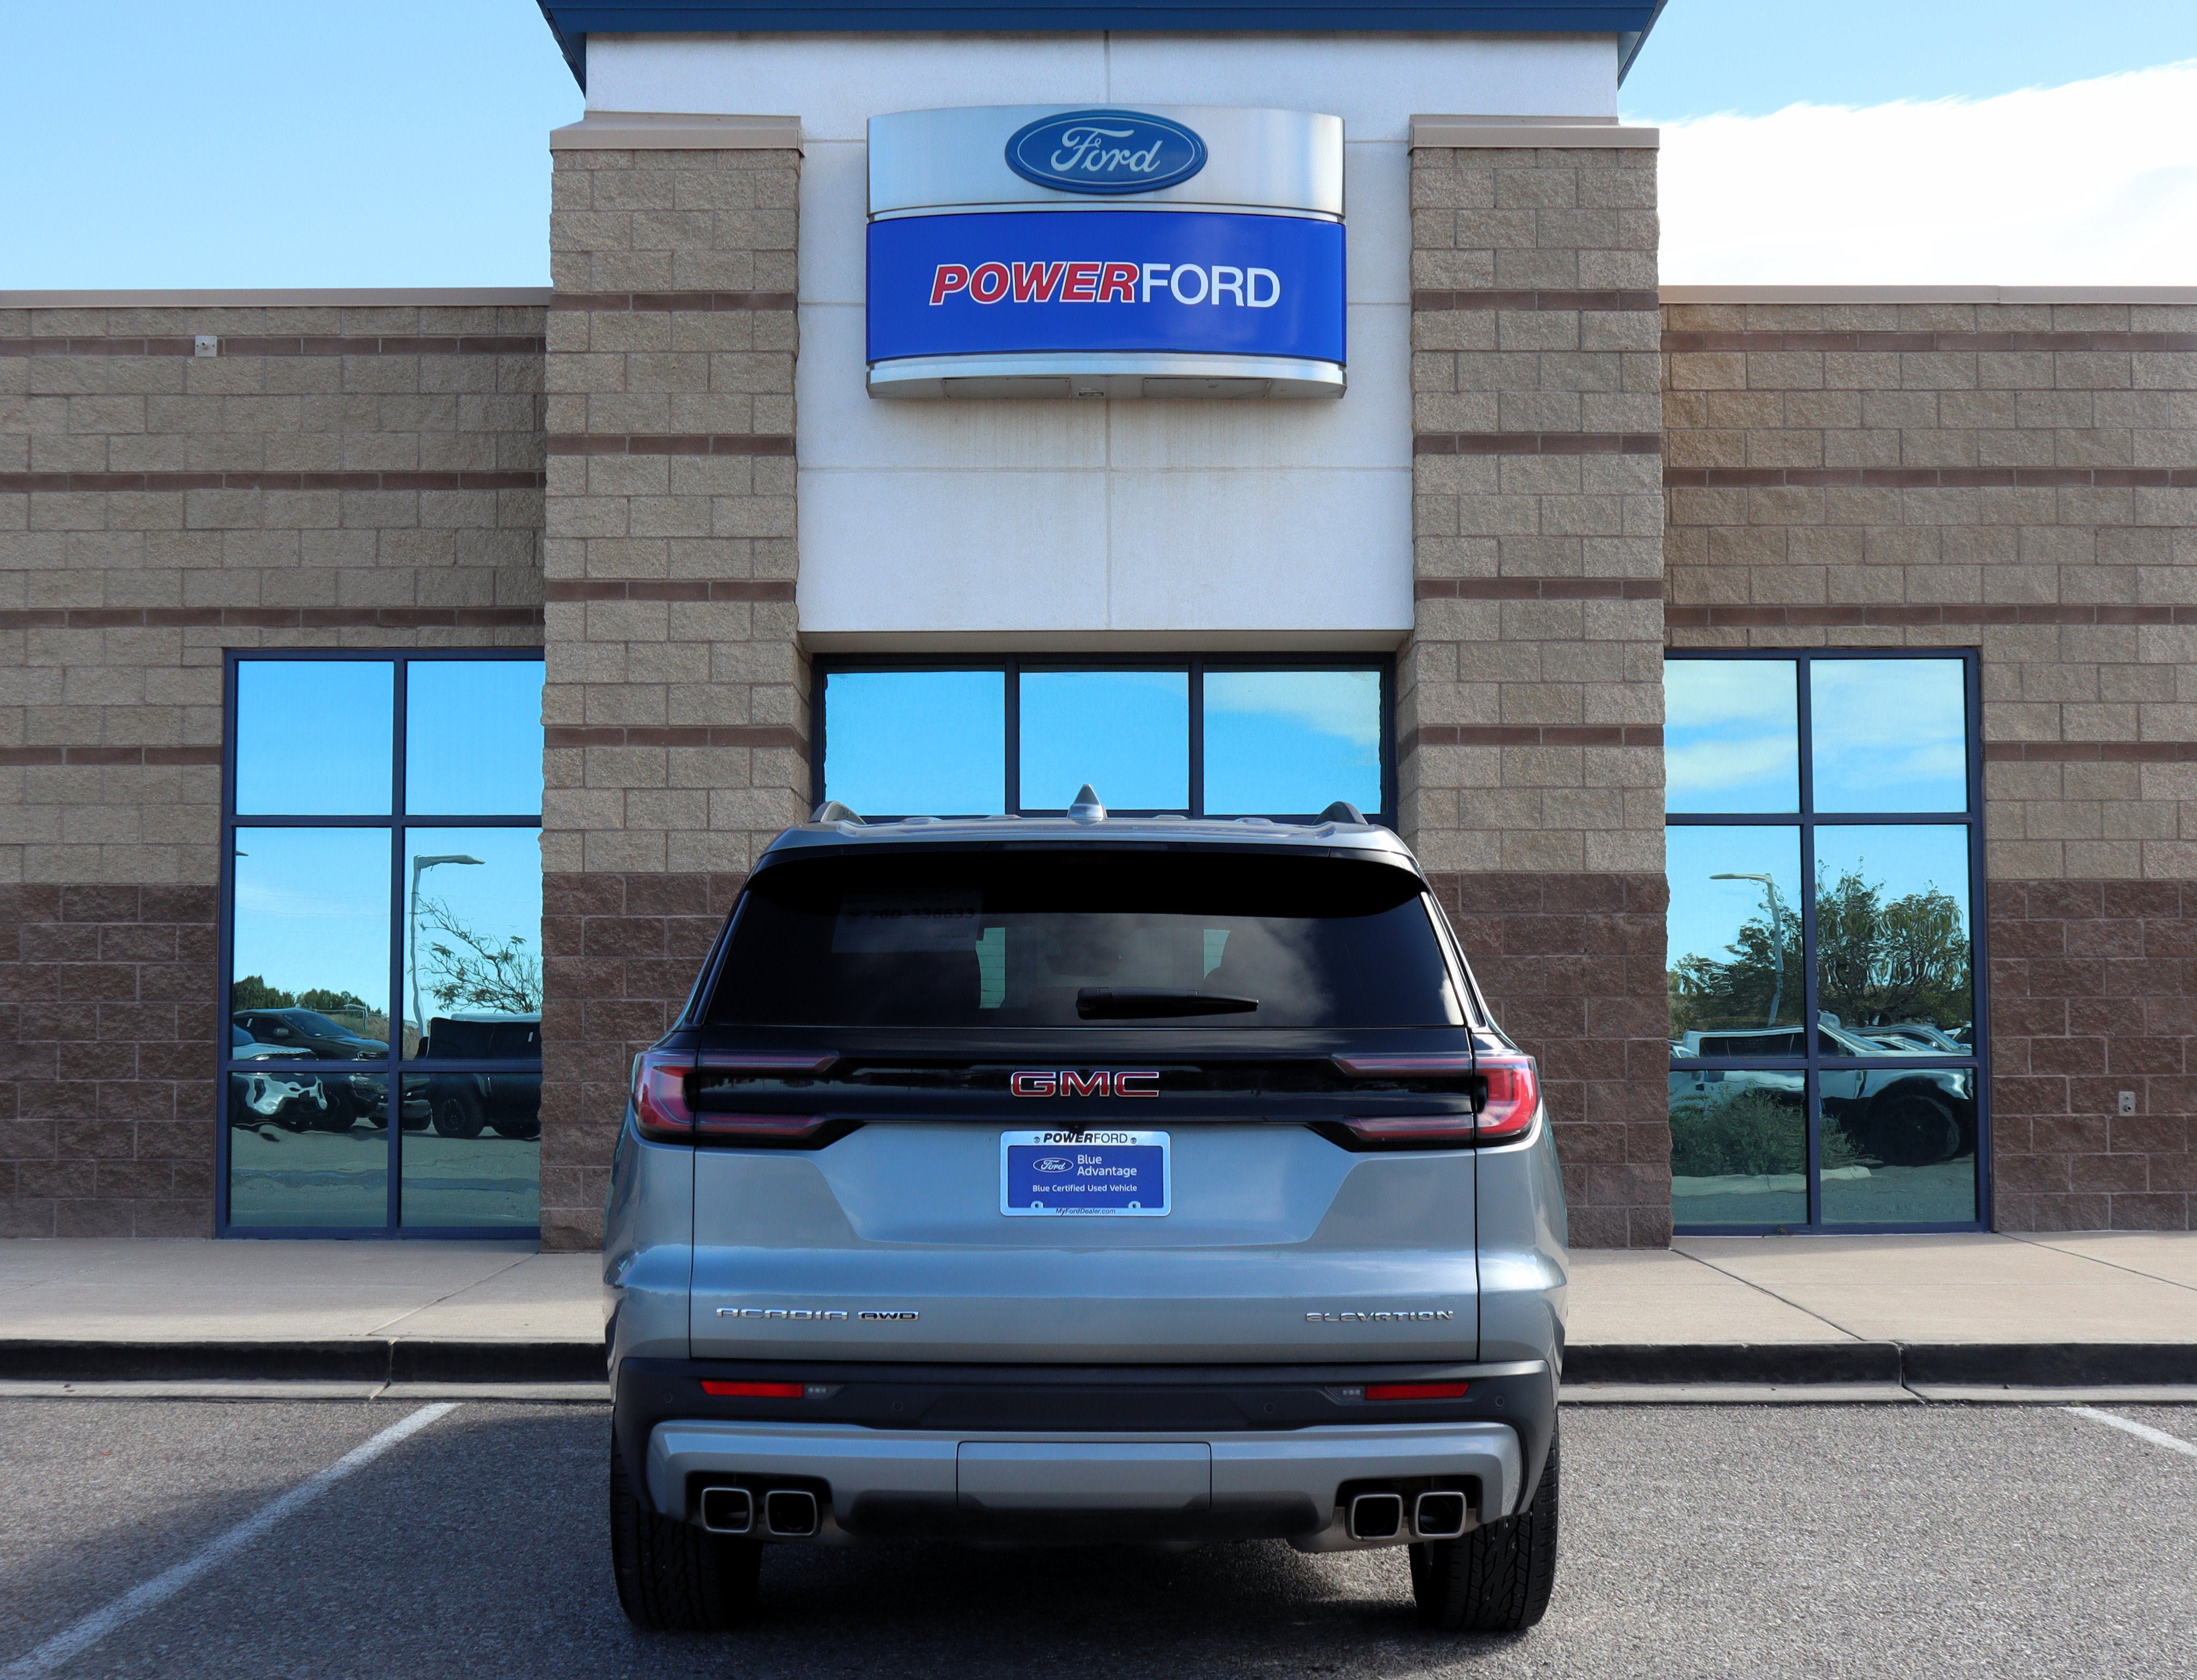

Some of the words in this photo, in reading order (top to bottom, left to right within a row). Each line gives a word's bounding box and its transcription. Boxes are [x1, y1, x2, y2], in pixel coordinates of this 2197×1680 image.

[1051, 127, 1161, 173] Ford
[930, 262, 1281, 308] POWERFORD
[1011, 1071, 1159, 1097] GMC
[1043, 1133, 1128, 1143] POWERFORD
[1041, 1160, 1066, 1170] Ford
[1077, 1155, 1102, 1164] Blue
[1077, 1166, 1137, 1178] Advantage
[1055, 1208, 1116, 1216] MyFordDealer.com
[716, 1308, 849, 1321] ACADIA
[1306, 1311, 1454, 1322] ELEVATION
